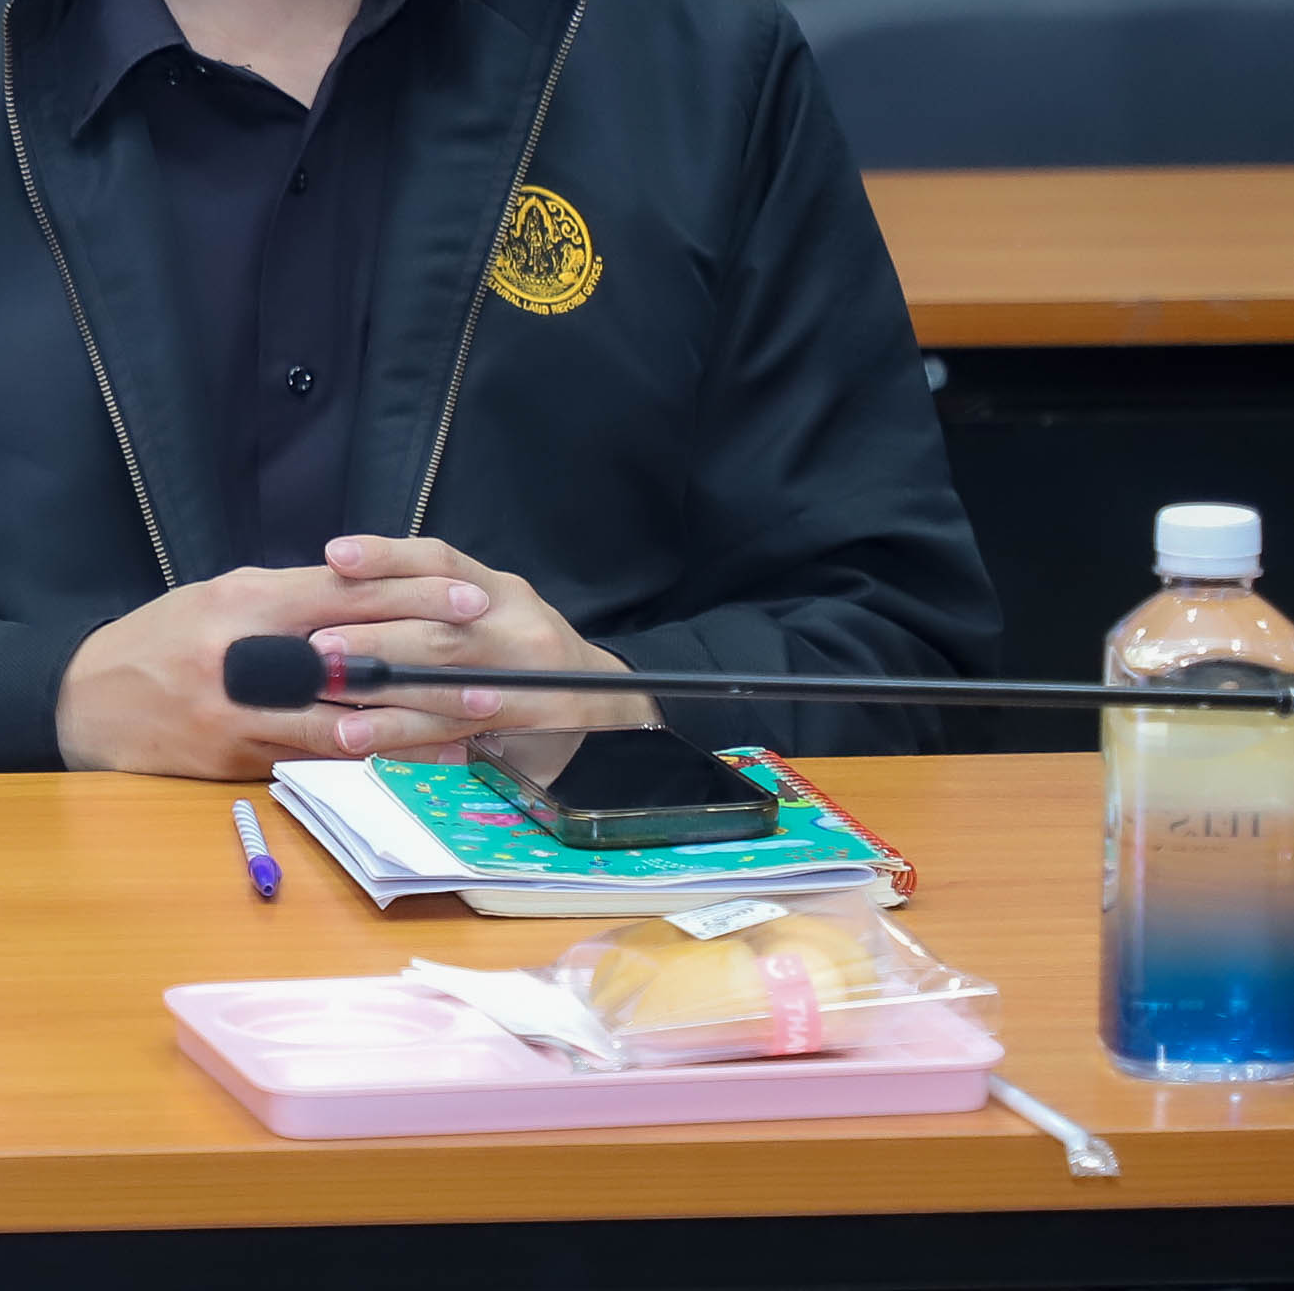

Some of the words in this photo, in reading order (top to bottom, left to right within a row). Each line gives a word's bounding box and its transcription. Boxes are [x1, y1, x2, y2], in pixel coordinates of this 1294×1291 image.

[523, 300, 550, 315] LAND
[550, 292, 587, 314] REFORM
[582, 262, 603, 296] OFFICE
